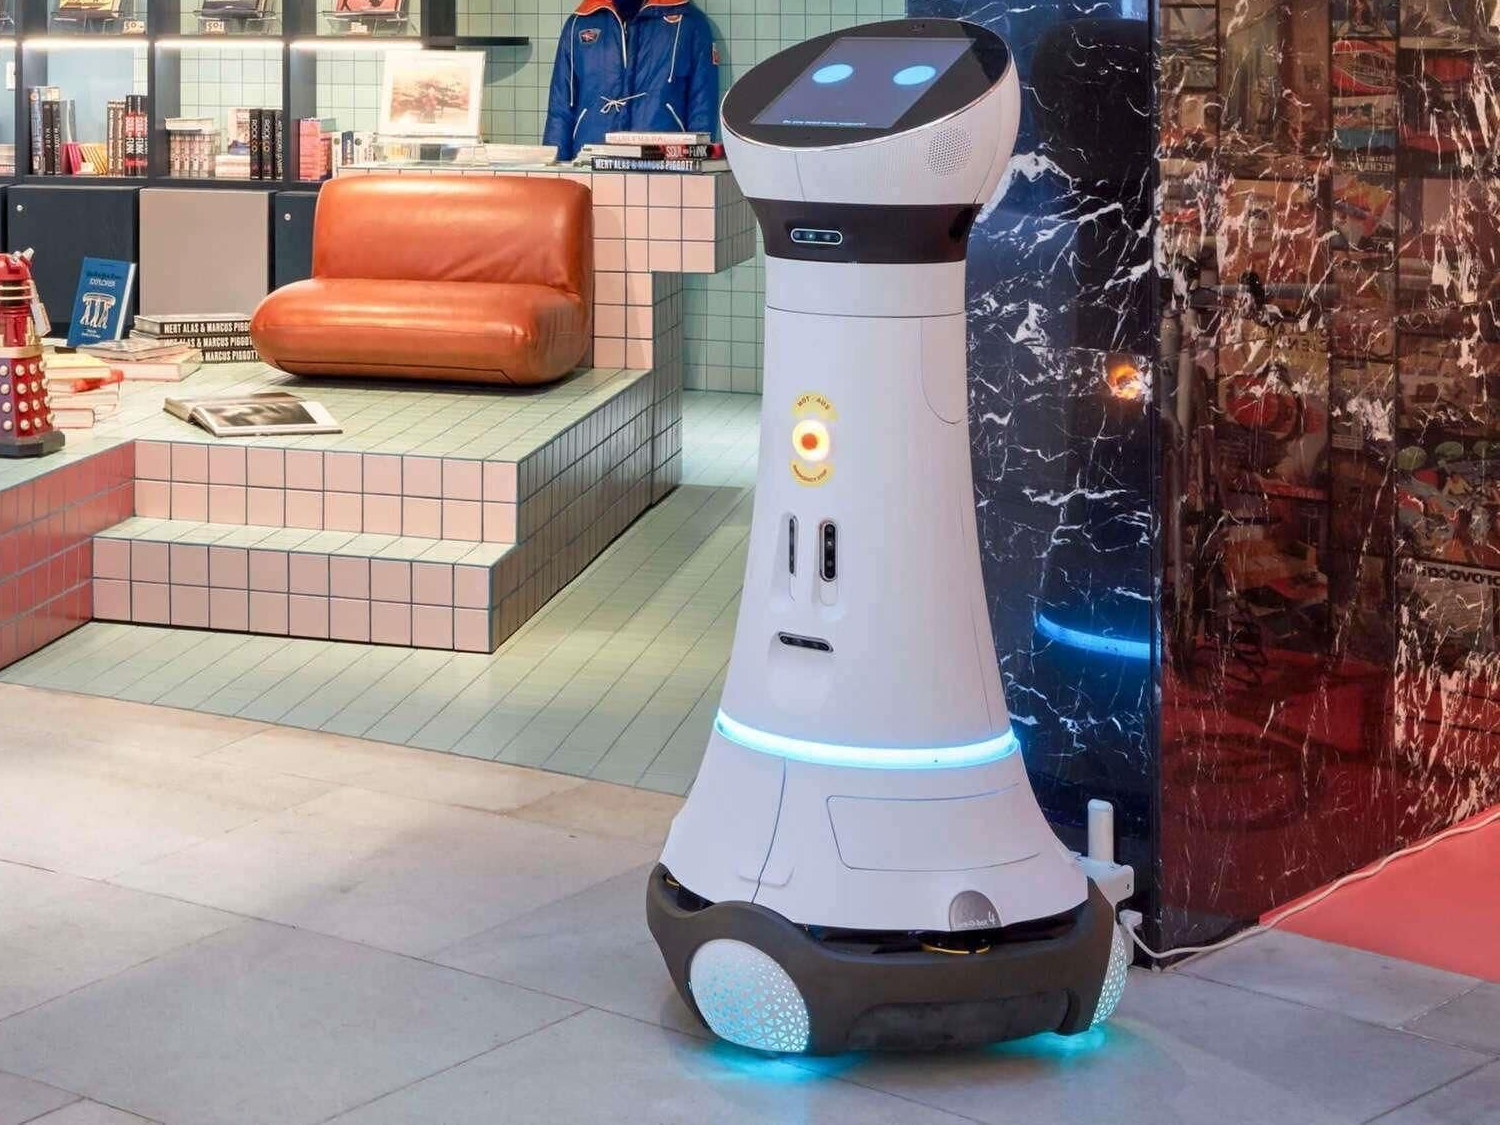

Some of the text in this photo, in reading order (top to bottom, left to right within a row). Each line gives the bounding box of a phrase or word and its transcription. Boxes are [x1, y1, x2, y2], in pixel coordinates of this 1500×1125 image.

[182, 323, 199, 333] ALAS
[206, 322, 233, 333] MARCUS
[203, 337, 229, 348] MARCUS
[229, 336, 252, 347] PIGGOT
[205, 350, 231, 361] MARCUS
